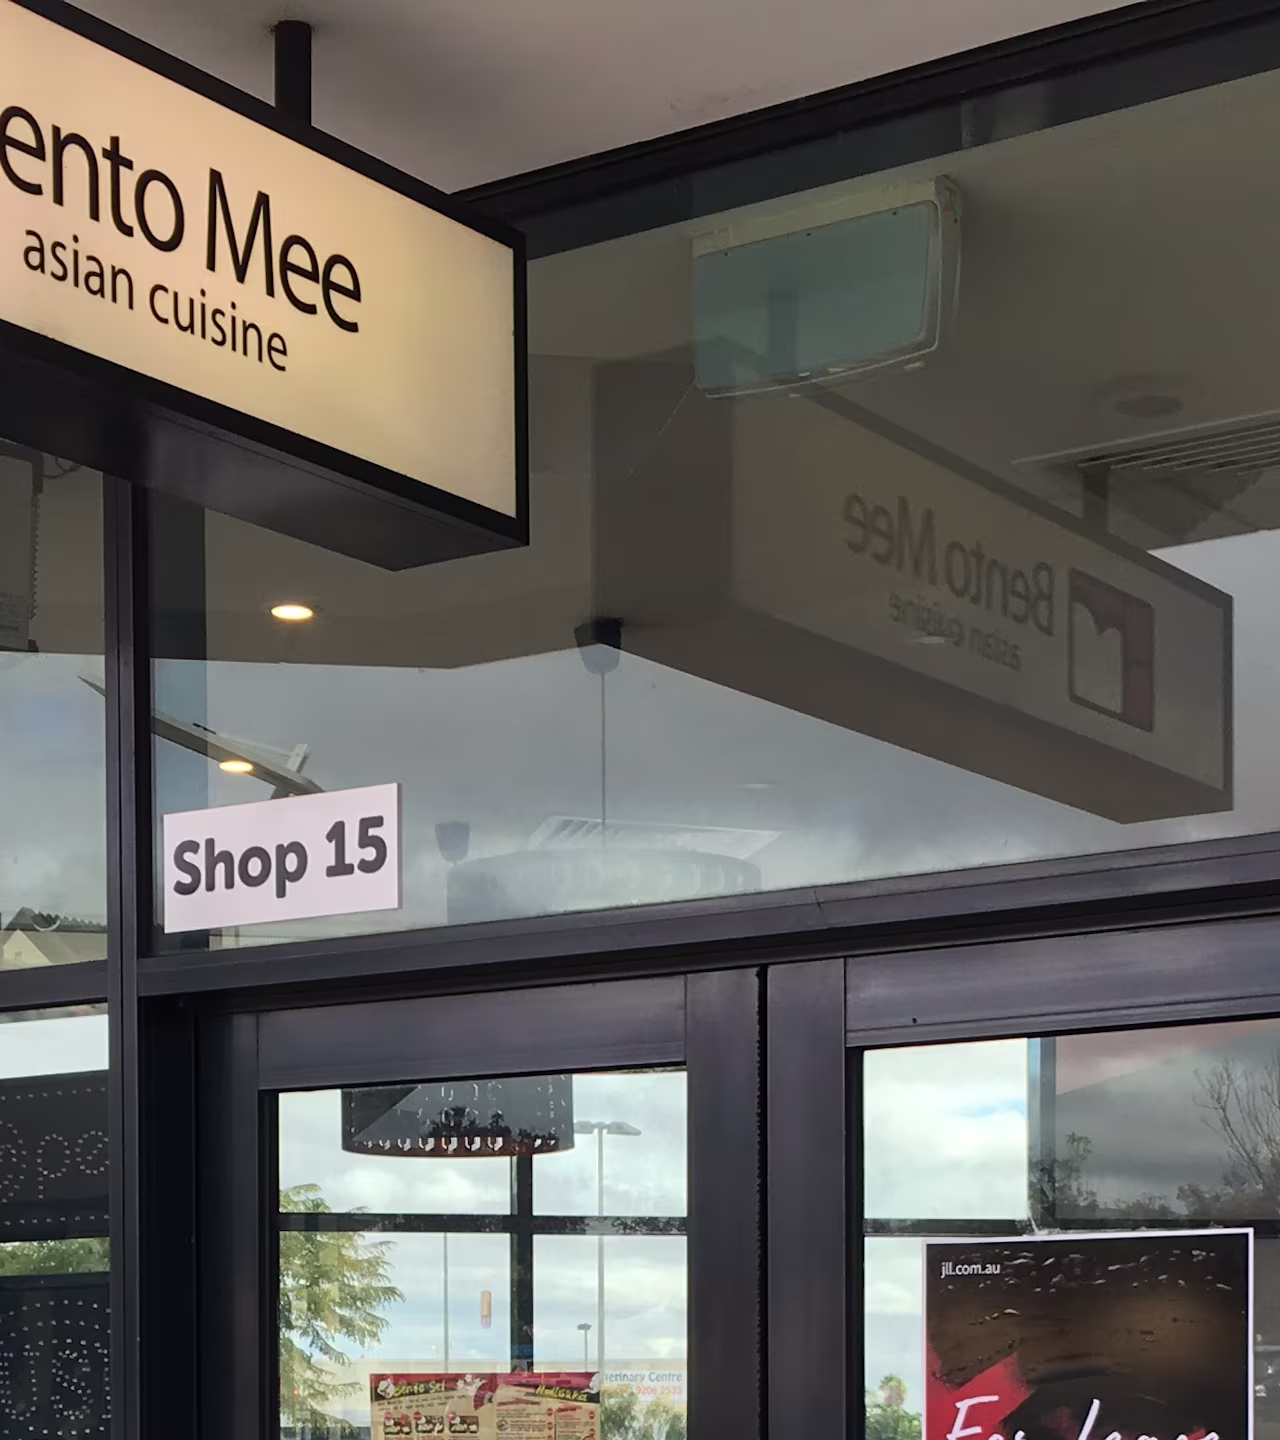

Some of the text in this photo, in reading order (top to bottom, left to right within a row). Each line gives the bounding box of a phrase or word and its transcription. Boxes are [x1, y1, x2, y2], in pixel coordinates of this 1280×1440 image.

[205, 168, 363, 334] Mee
[22, 224, 288, 373] asian cuisine
[173, 815, 388, 899] Shop 15
[940, 1261, 1001, 1279] jll.com.au
[648, 1372, 682, 1382] Centre
